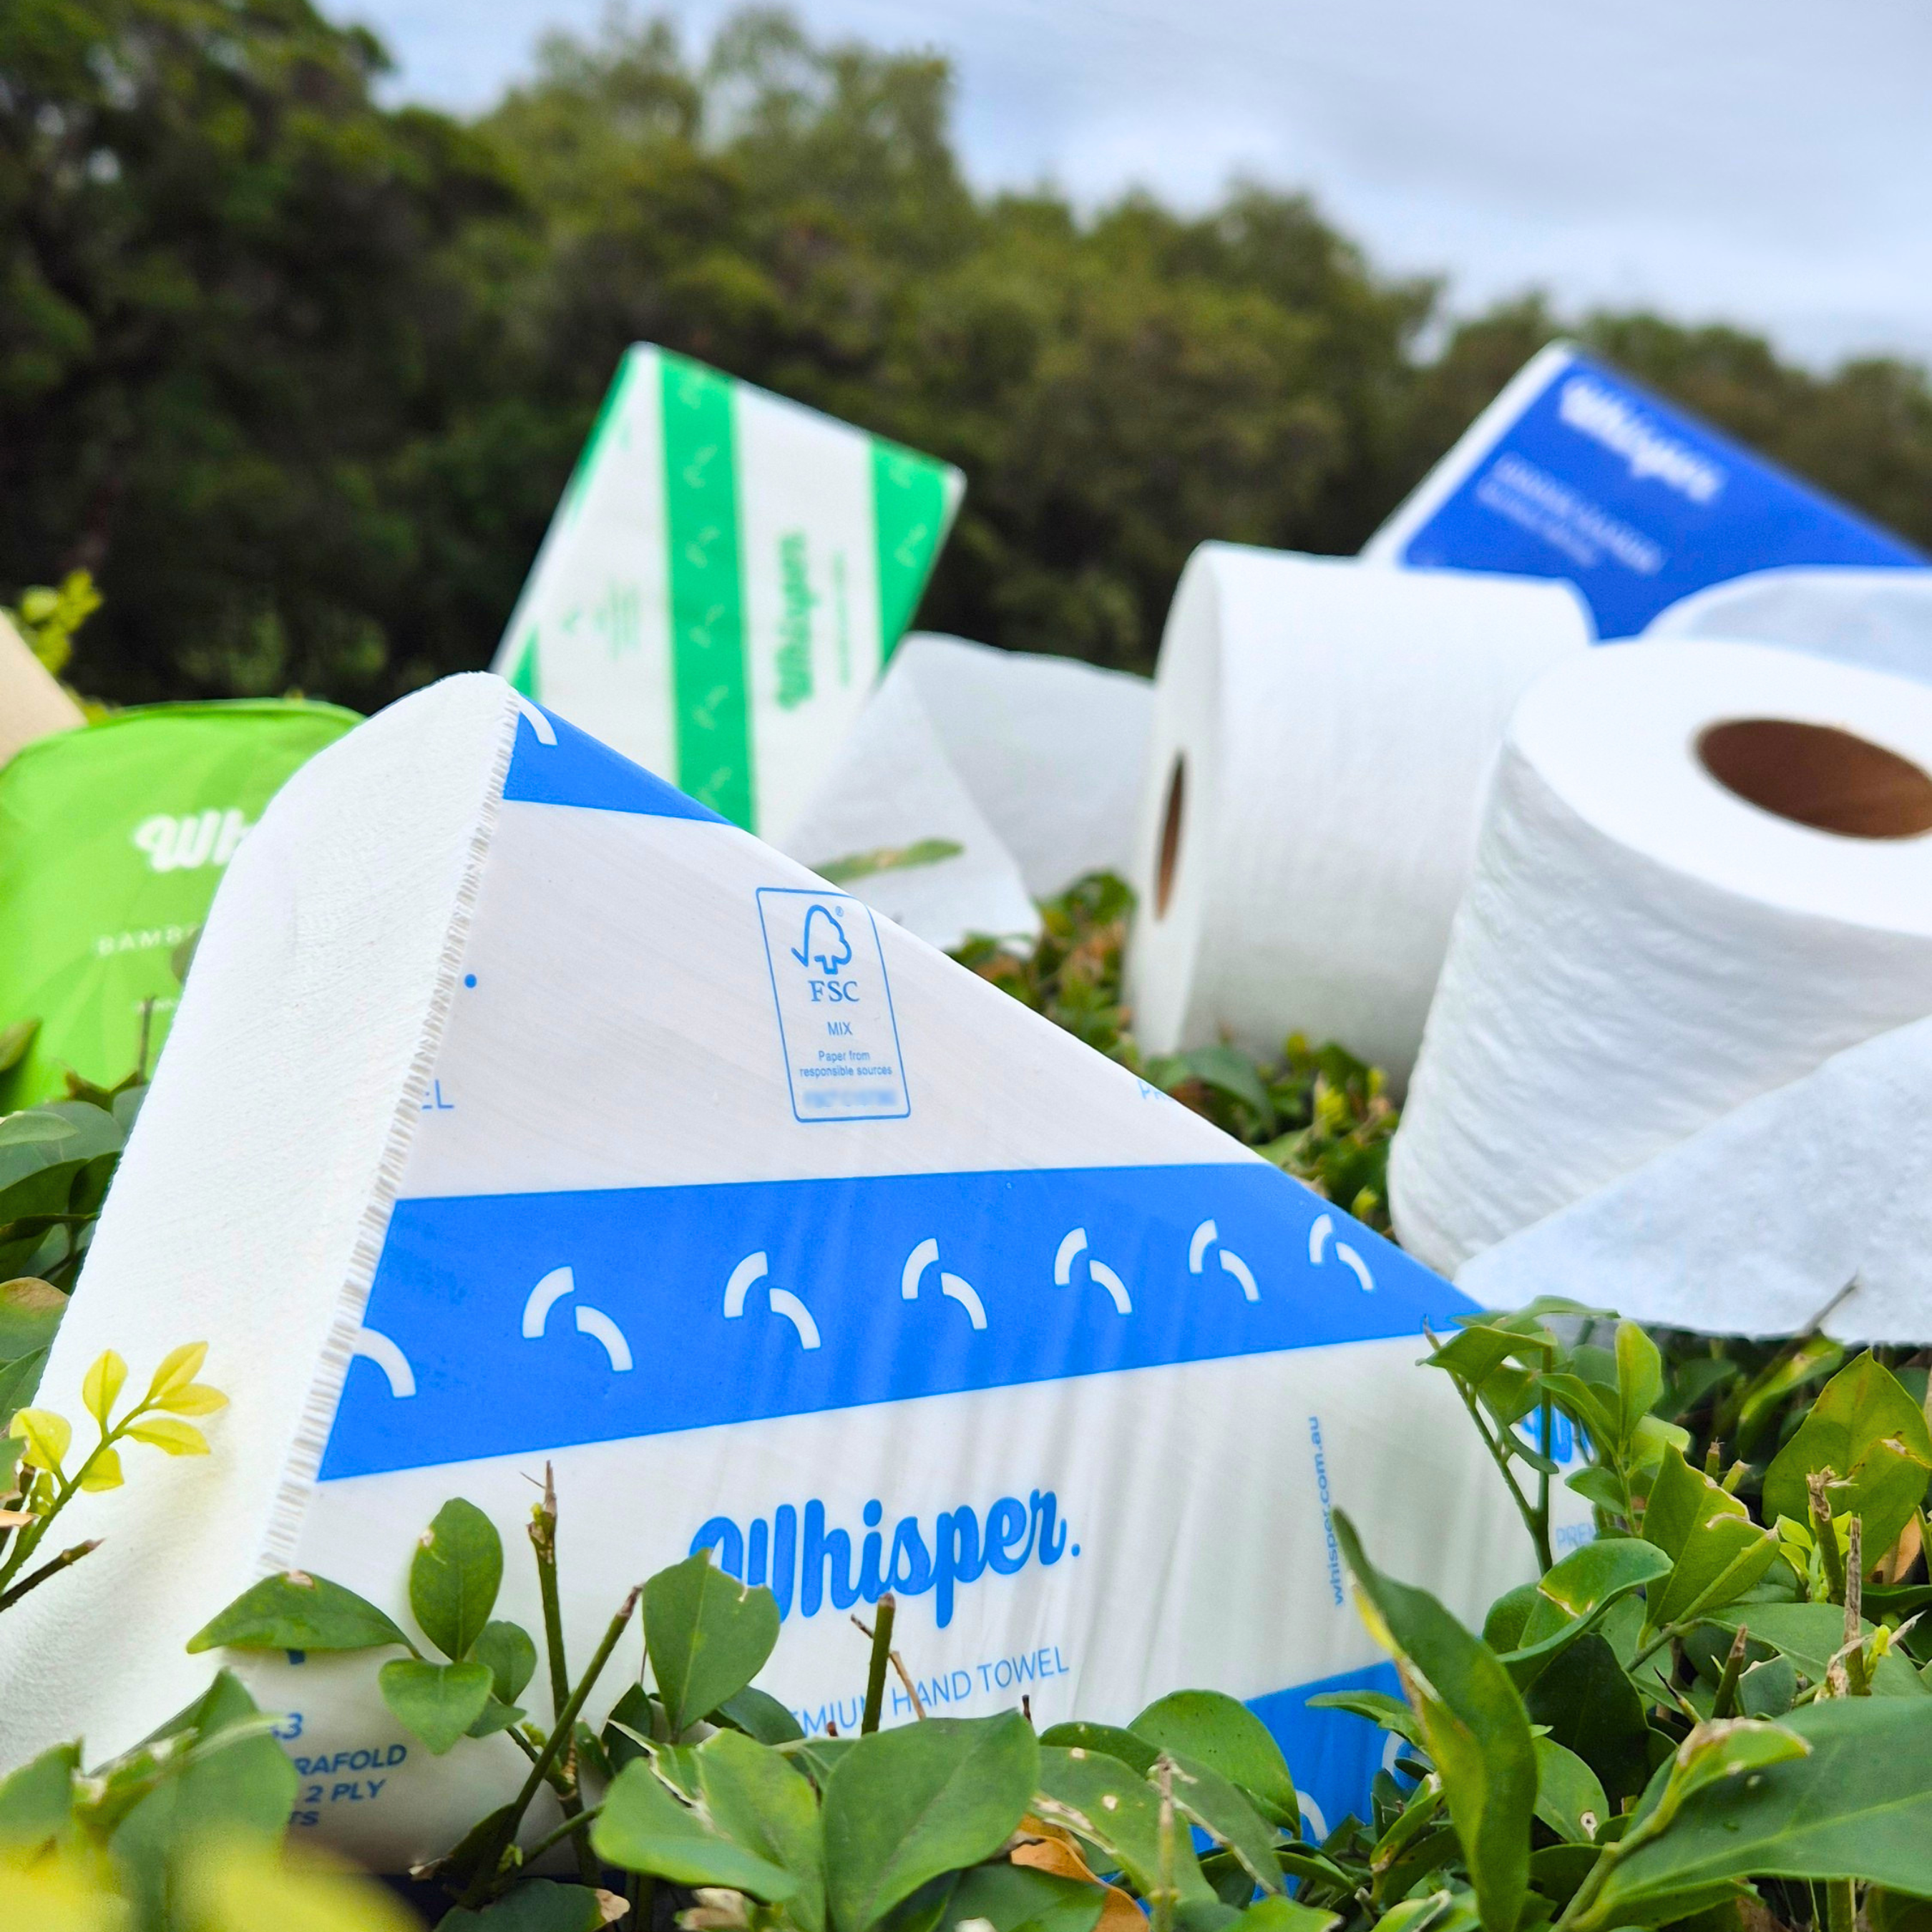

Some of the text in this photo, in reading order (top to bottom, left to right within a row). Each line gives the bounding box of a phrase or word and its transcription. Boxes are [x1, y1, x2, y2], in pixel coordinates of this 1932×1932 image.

[808, 980, 861, 1002] FSC
[827, 1021, 854, 1036] MIX
[818, 1050, 871, 1063] Paper from
[799, 1065, 893, 1078] responsible sources
[892, 1669, 972, 1717] HAND
[977, 1645, 1070, 1693] TOWEL
[304, 1779, 386, 1804] 2 PLY
